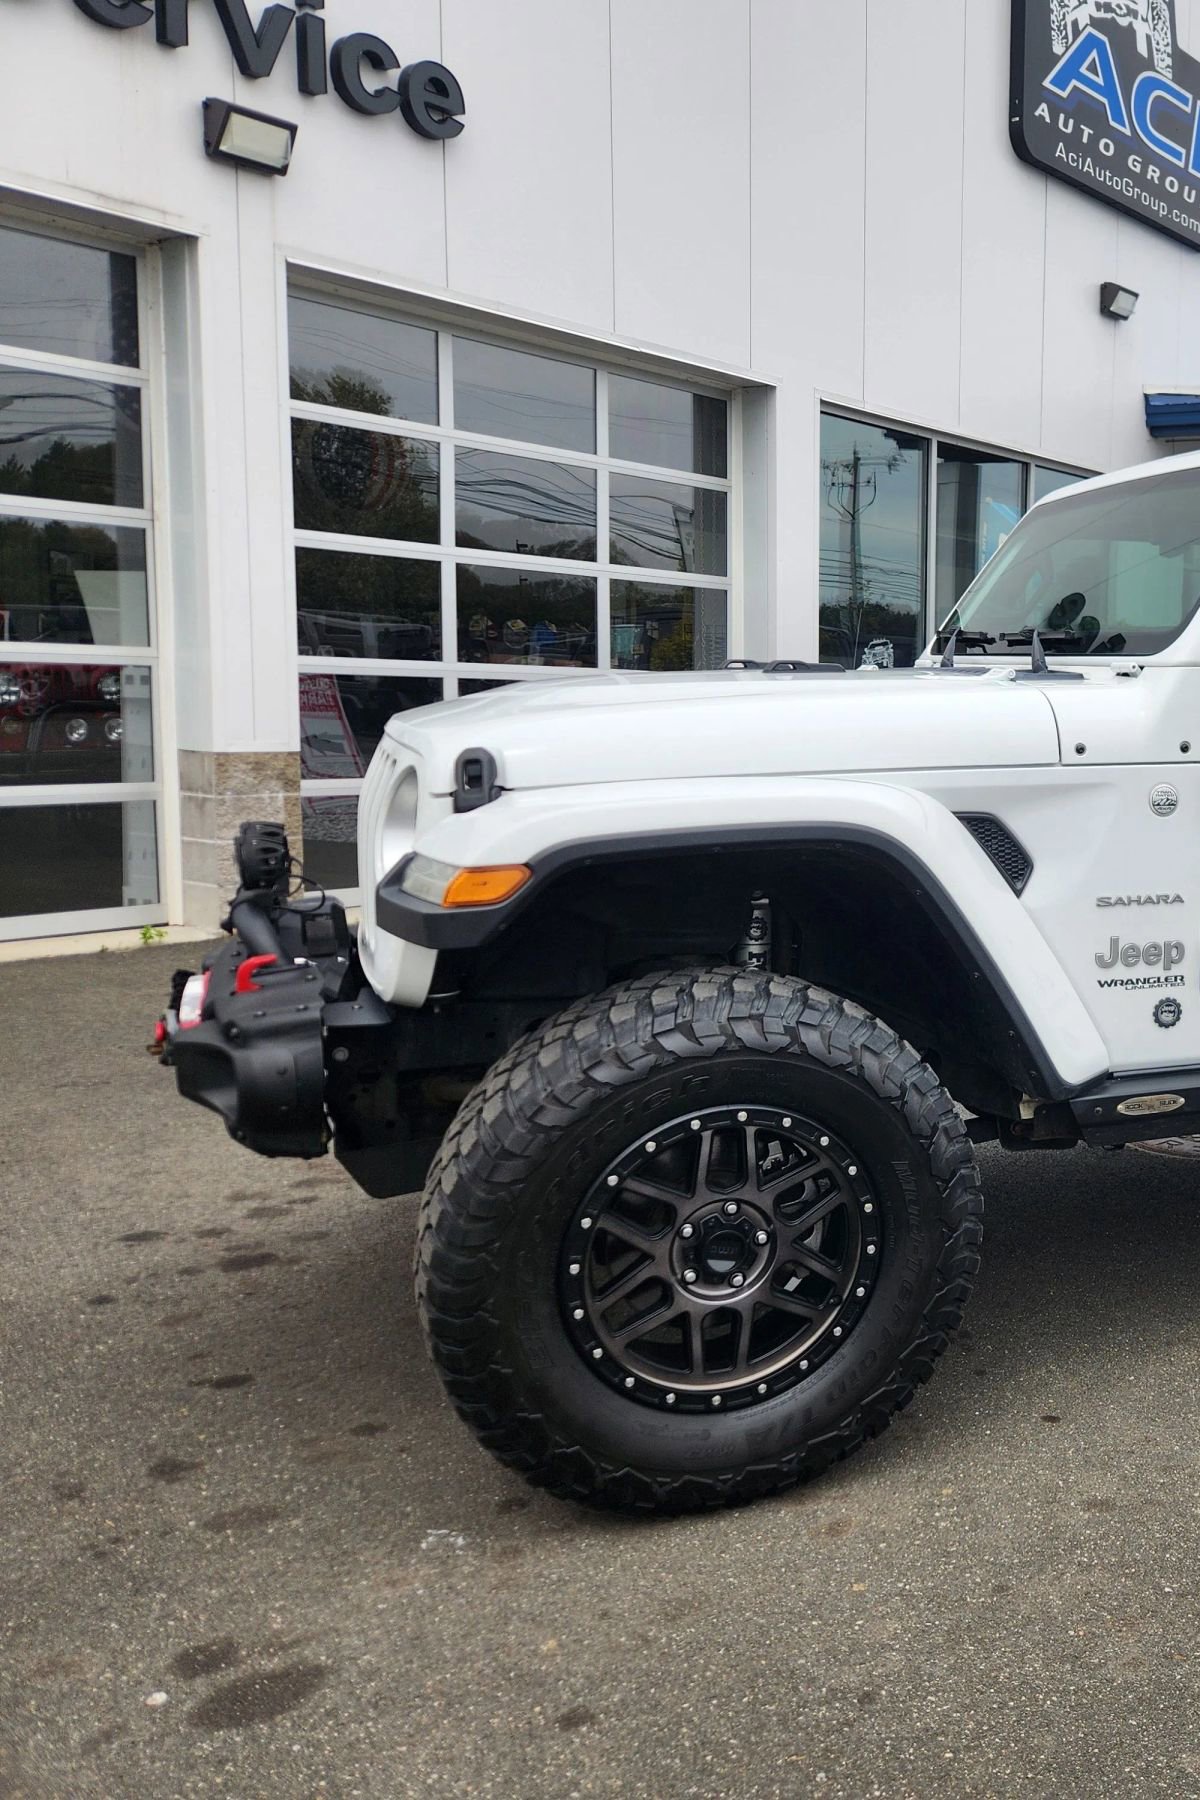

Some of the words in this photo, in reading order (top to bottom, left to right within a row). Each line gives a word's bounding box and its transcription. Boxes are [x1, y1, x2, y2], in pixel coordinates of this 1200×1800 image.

[1034, 102, 1115, 157] AUTO
[1096, 893, 1184, 907] SAHARA
[1095, 935, 1185, 971] Jeep
[1097, 975, 1184, 989] WRANGLER
[1125, 982, 1185, 991] UNLIMITED
